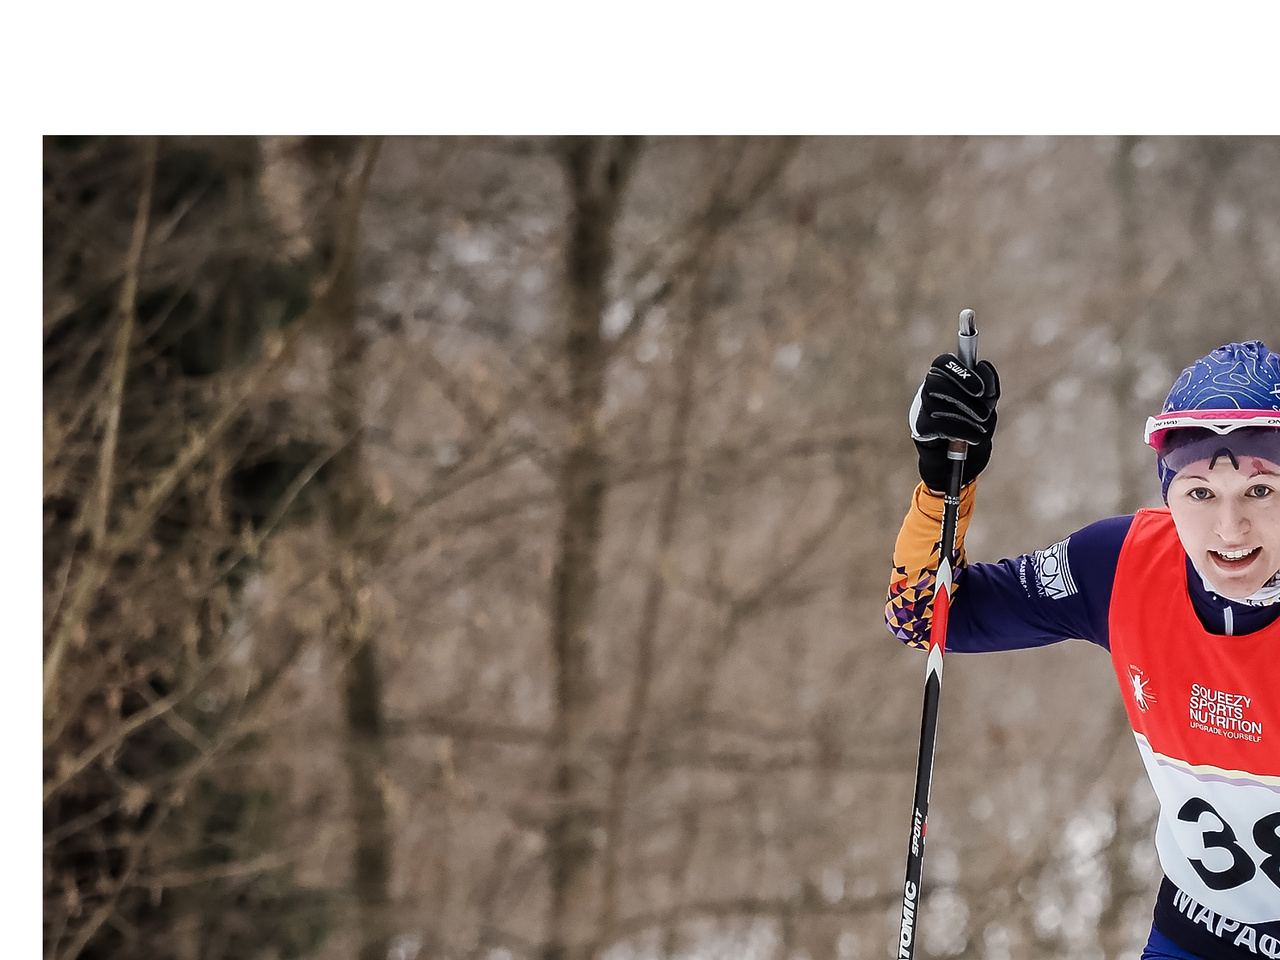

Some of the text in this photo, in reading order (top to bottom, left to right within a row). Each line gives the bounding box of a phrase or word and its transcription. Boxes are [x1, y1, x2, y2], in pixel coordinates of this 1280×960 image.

[1189, 696, 1243, 719] SPORTS
[1190, 683, 1251, 708] SQUEEZY
[1189, 708, 1262, 735] NUTRITION
[1189, 721, 1262, 743] UPGRADE YOURSELF
[911, 807, 923, 857] SPORT
